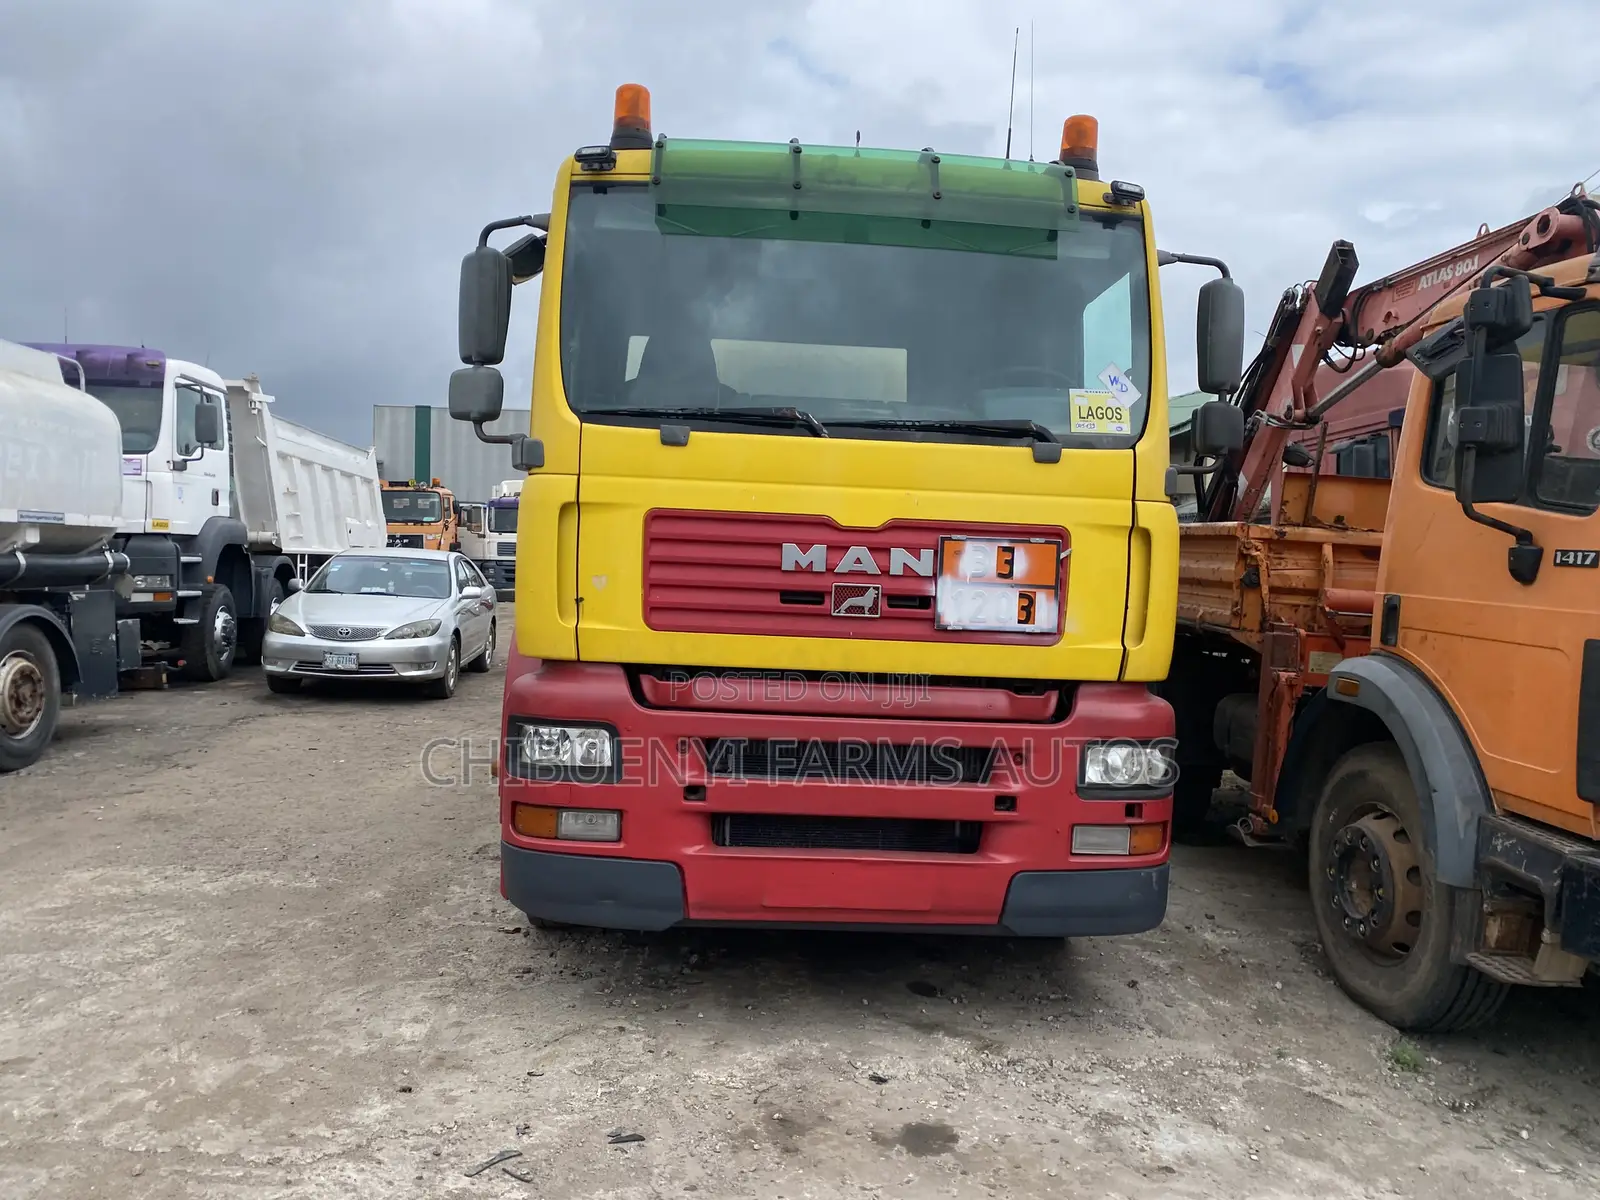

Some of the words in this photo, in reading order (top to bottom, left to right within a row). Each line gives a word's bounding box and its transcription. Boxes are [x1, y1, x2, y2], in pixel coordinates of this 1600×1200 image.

[1417, 264, 1454, 290] ATLAS
[1078, 405, 1122, 421] LAGOS
[781, 543, 934, 577] MAN
[1555, 551, 1597, 565] 1417
